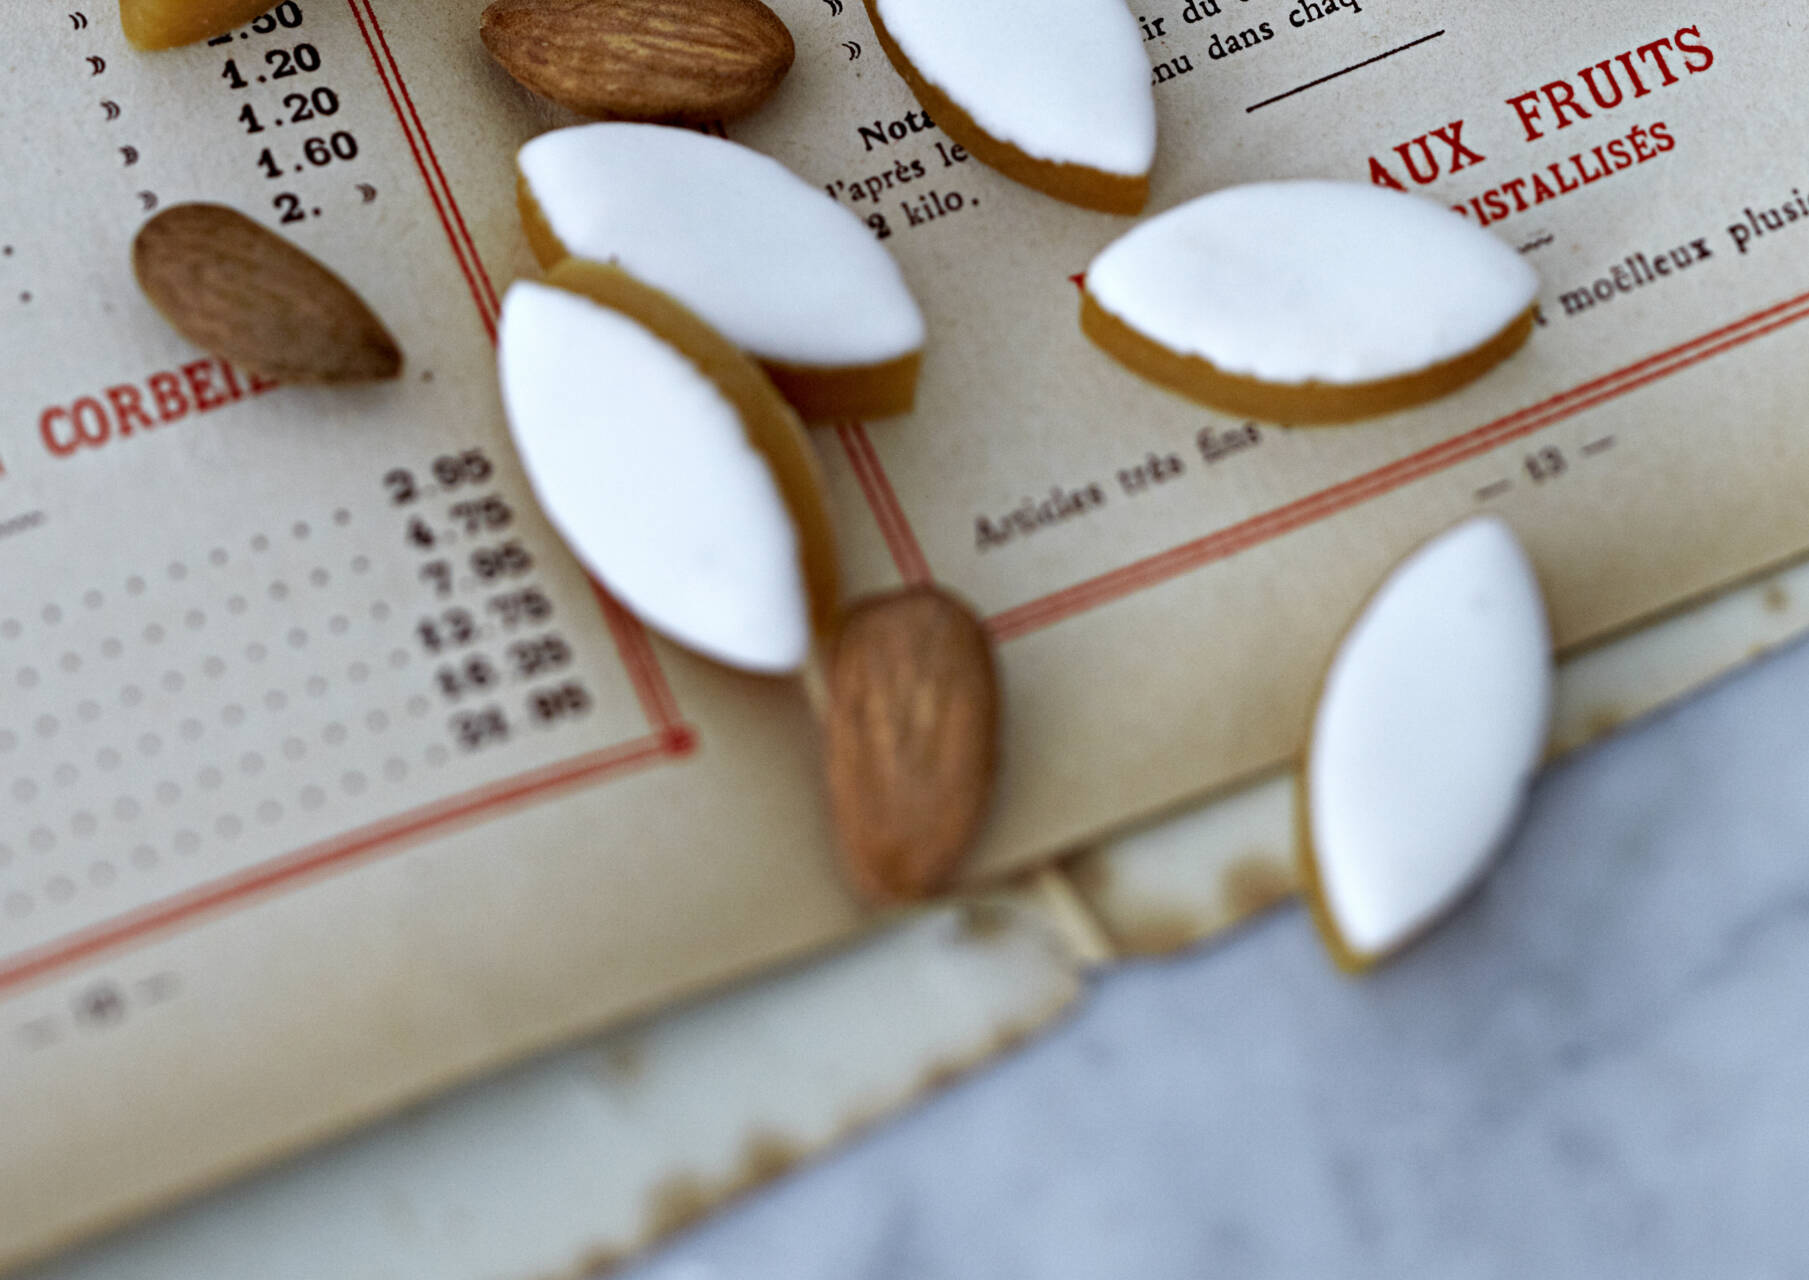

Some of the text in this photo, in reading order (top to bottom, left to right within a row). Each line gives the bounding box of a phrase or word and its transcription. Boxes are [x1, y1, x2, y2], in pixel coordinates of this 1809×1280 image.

[1207, 21, 1275, 61] dans
[221, 42, 321, 90] 1.20
[238, 86, 340, 135] 1.20
[1367, 23, 1716, 193] AUX FRUITS
[256, 130, 359, 179] 1.60
[900, 189, 980, 228] kilo.
[1726, 187, 1809, 255] plusi
